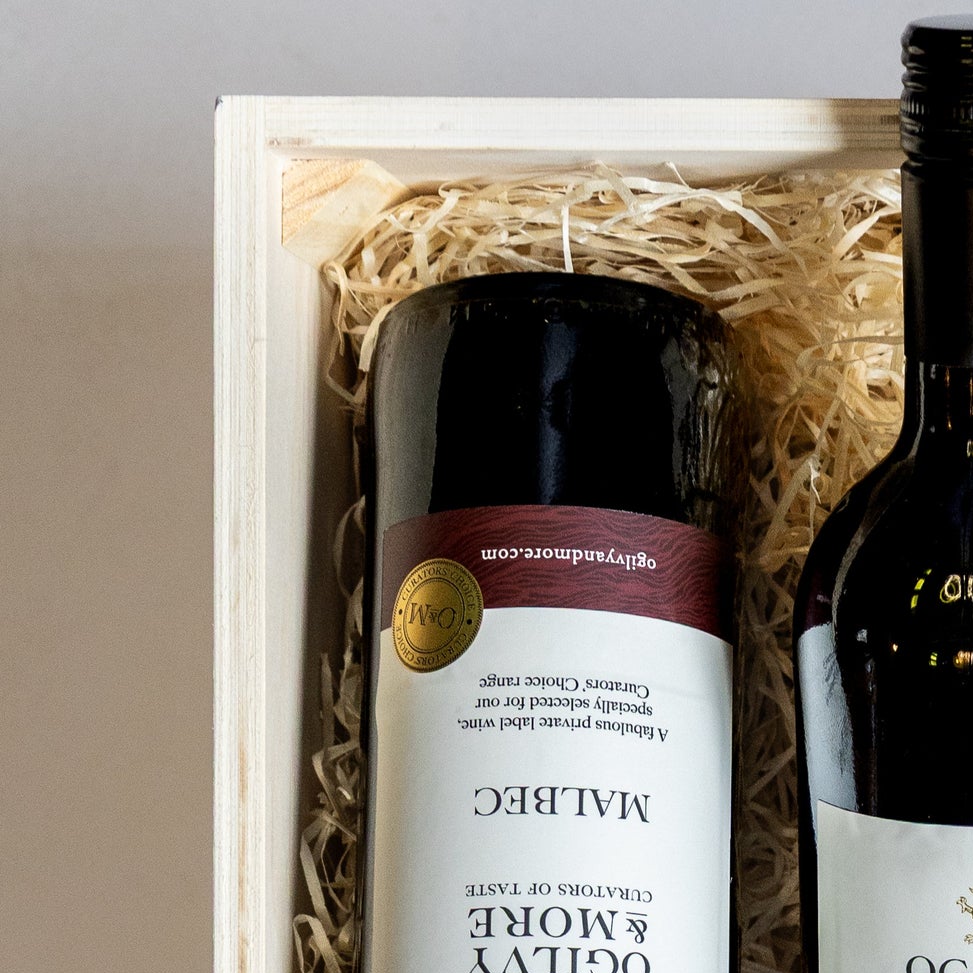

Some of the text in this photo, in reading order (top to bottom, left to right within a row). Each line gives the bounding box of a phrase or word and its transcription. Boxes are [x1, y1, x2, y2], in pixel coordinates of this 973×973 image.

[482, 548, 656, 570] ogilvyandmore.com
[408, 602, 456, 629] O&M
[480, 674, 649, 699] Curators' Choice range
[475, 694, 652, 716] specially selected for our
[458, 716, 668, 742] A fabulous private label wine,
[475, 786, 650, 823] MALBEC
[466, 883, 652, 902] CURATORS OF TASTE
[468, 906, 647, 944] & MORE
